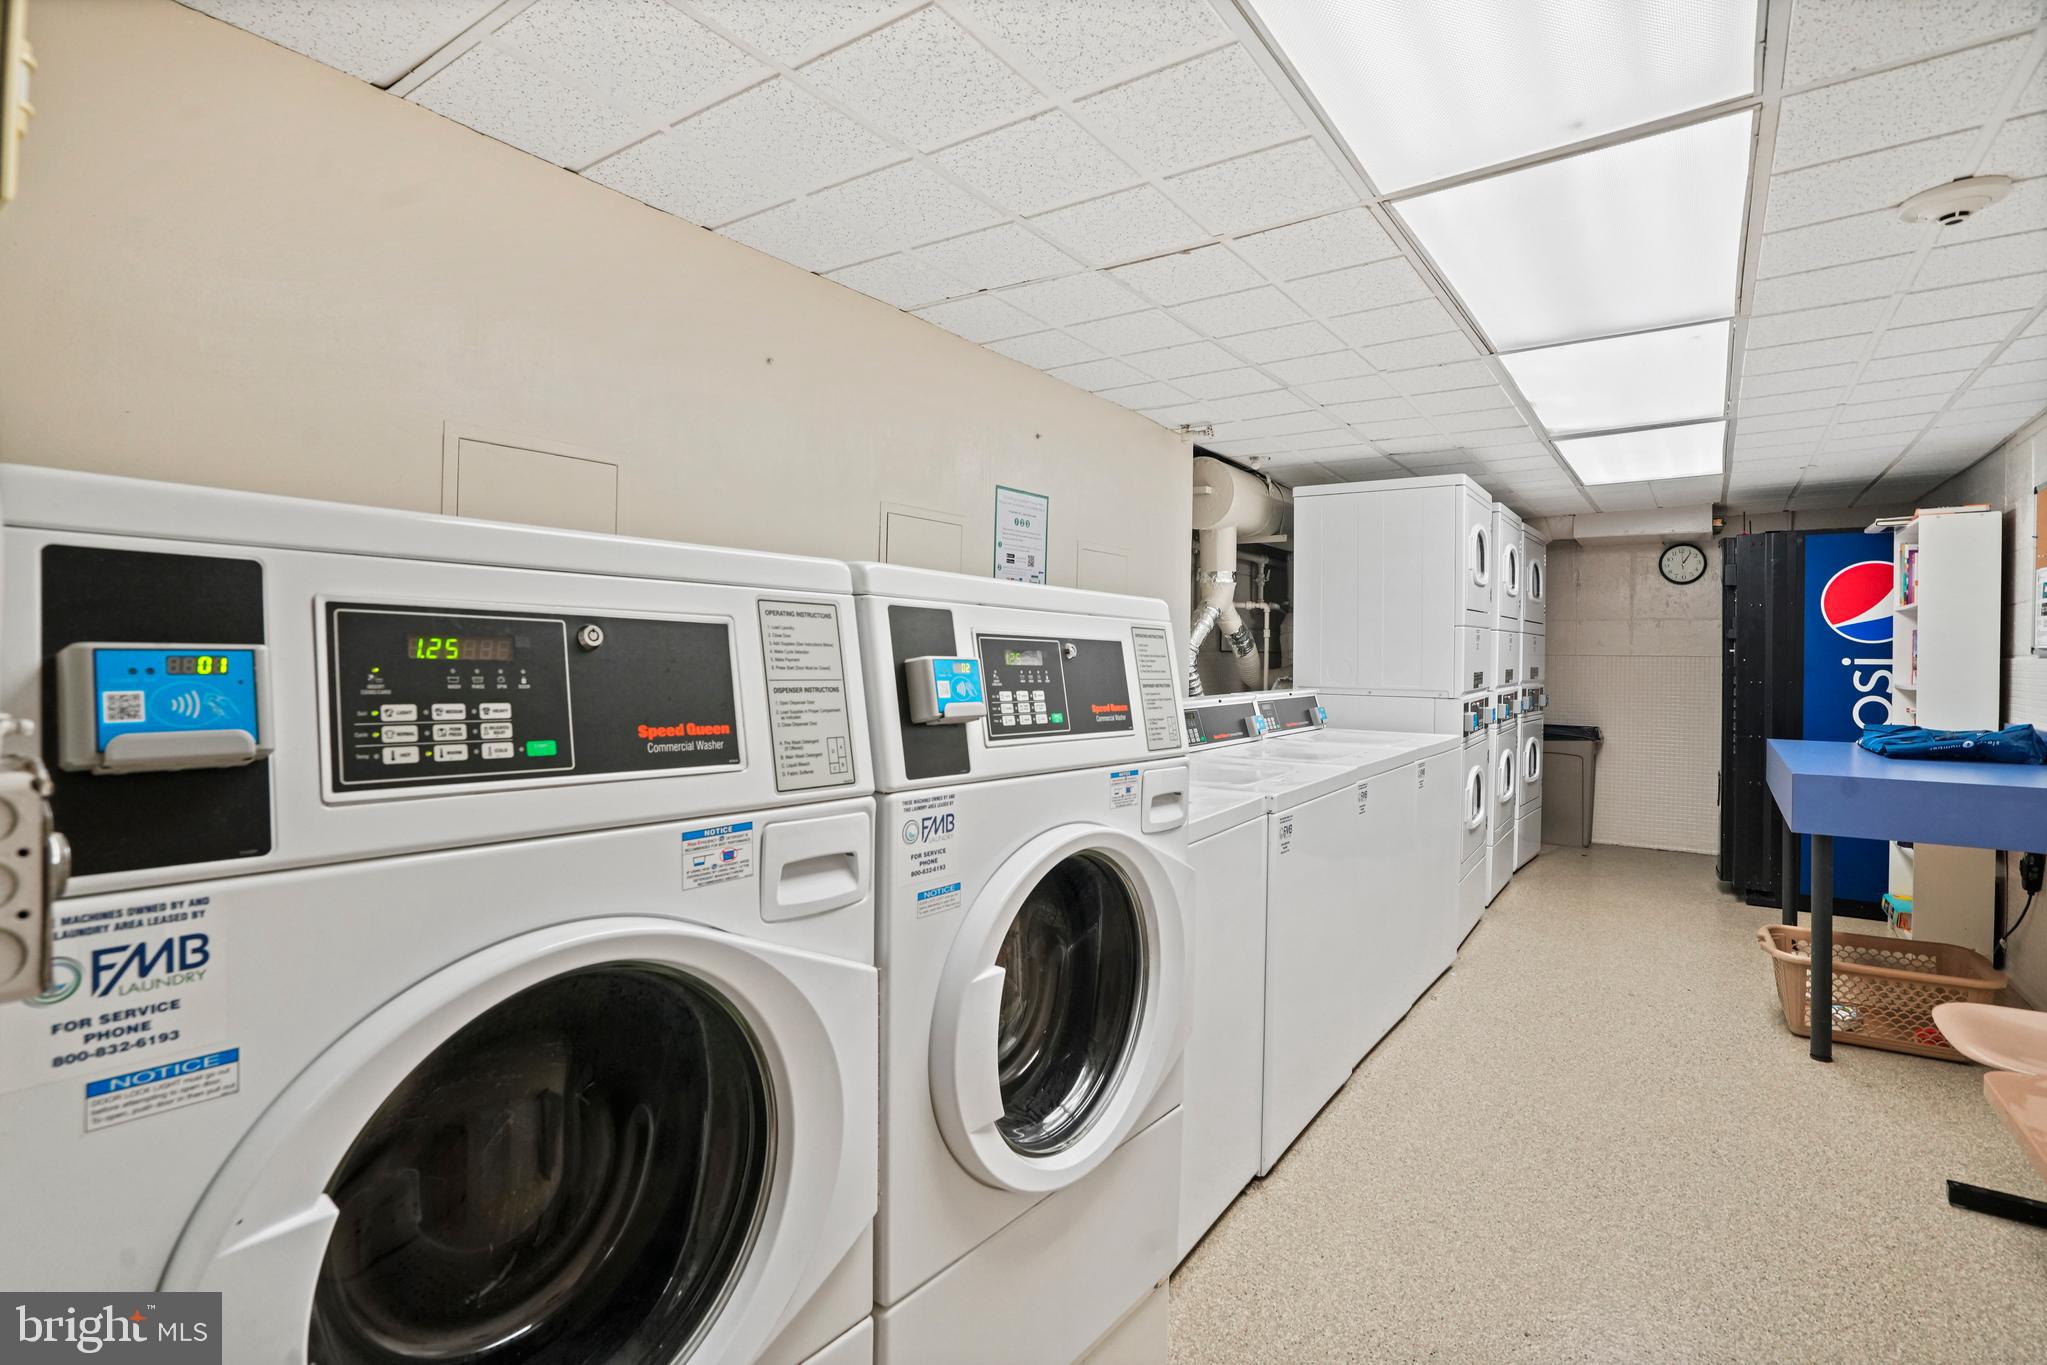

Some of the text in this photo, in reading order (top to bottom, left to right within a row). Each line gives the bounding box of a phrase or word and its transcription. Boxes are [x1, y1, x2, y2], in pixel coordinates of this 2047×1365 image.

[196, 656, 229, 675] 01
[638, 722, 730, 740] Speed Queen
[657, 740, 735, 753] Commercial Washer
[703, 825, 733, 837] NOTICE
[921, 813, 955, 843] FMB
[910, 847, 947, 861] FOR SERVICE
[919, 858, 938, 867] PHONE
[923, 884, 955, 898] NOTICE
[60, 896, 210, 926] MACHINES OWNED BY AND
[53, 909, 206, 941] LAUNDRY AREA LEASED BY
[91, 933, 210, 998] FMB
[118, 969, 208, 997] LAUNDRY
[50, 999, 182, 1036] FOR SERVICE
[83, 1020, 153, 1045] PHONE
[51, 1030, 181, 1068] 800-832-6193
[109, 1054, 221, 1091] NOTICE
